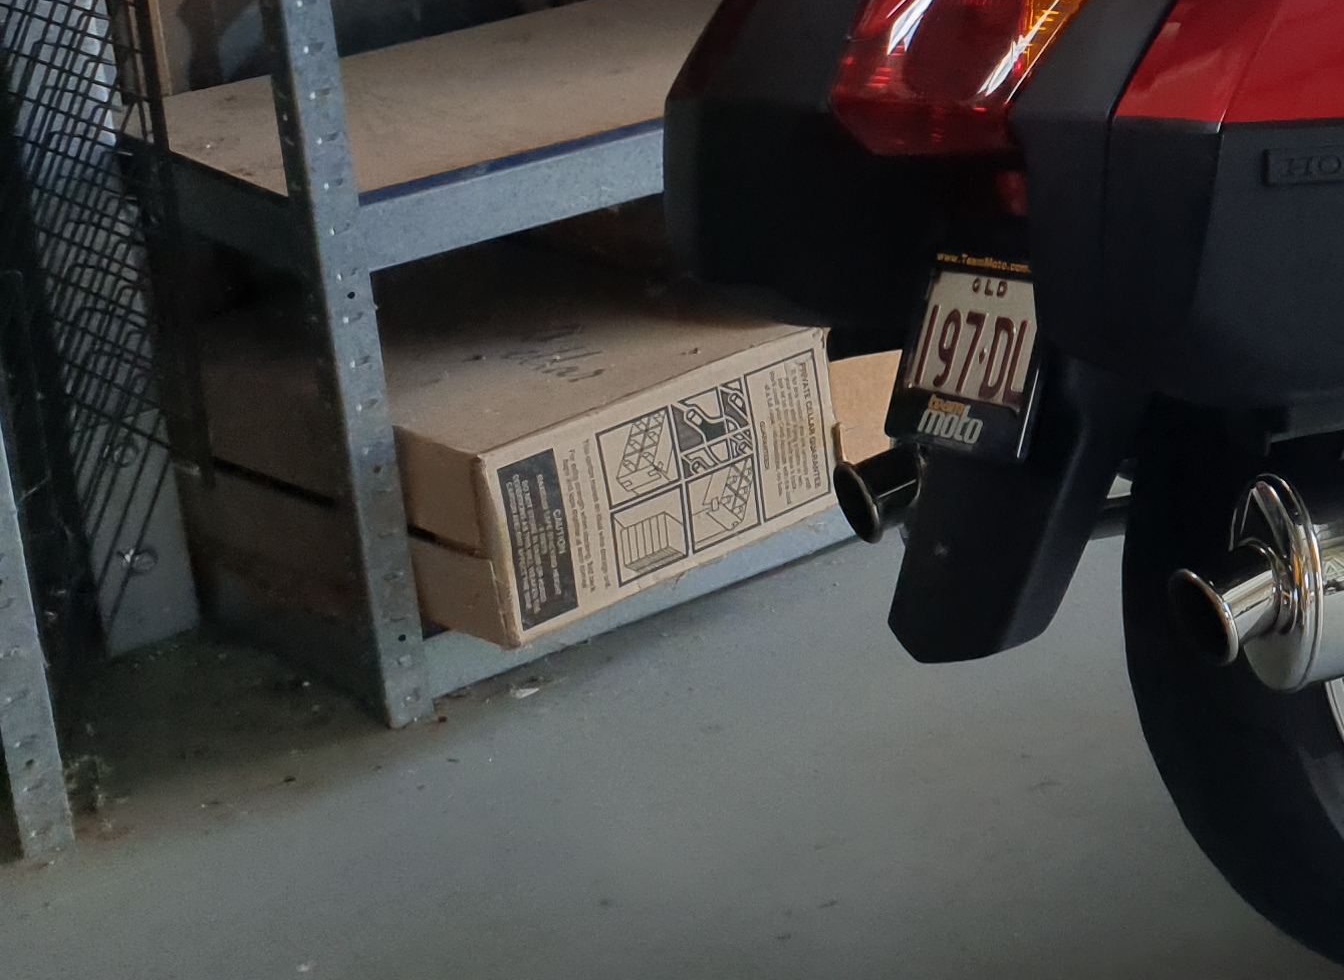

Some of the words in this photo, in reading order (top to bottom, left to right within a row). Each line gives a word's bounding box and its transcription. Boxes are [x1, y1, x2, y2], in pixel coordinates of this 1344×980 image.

[799, 361, 810, 400] PRIVATE
[804, 399, 816, 436] CELLAR
[917, 405, 984, 444] moto
[808, 435, 821, 489] GUARANTEE
[551, 507, 568, 555] CAUTION
